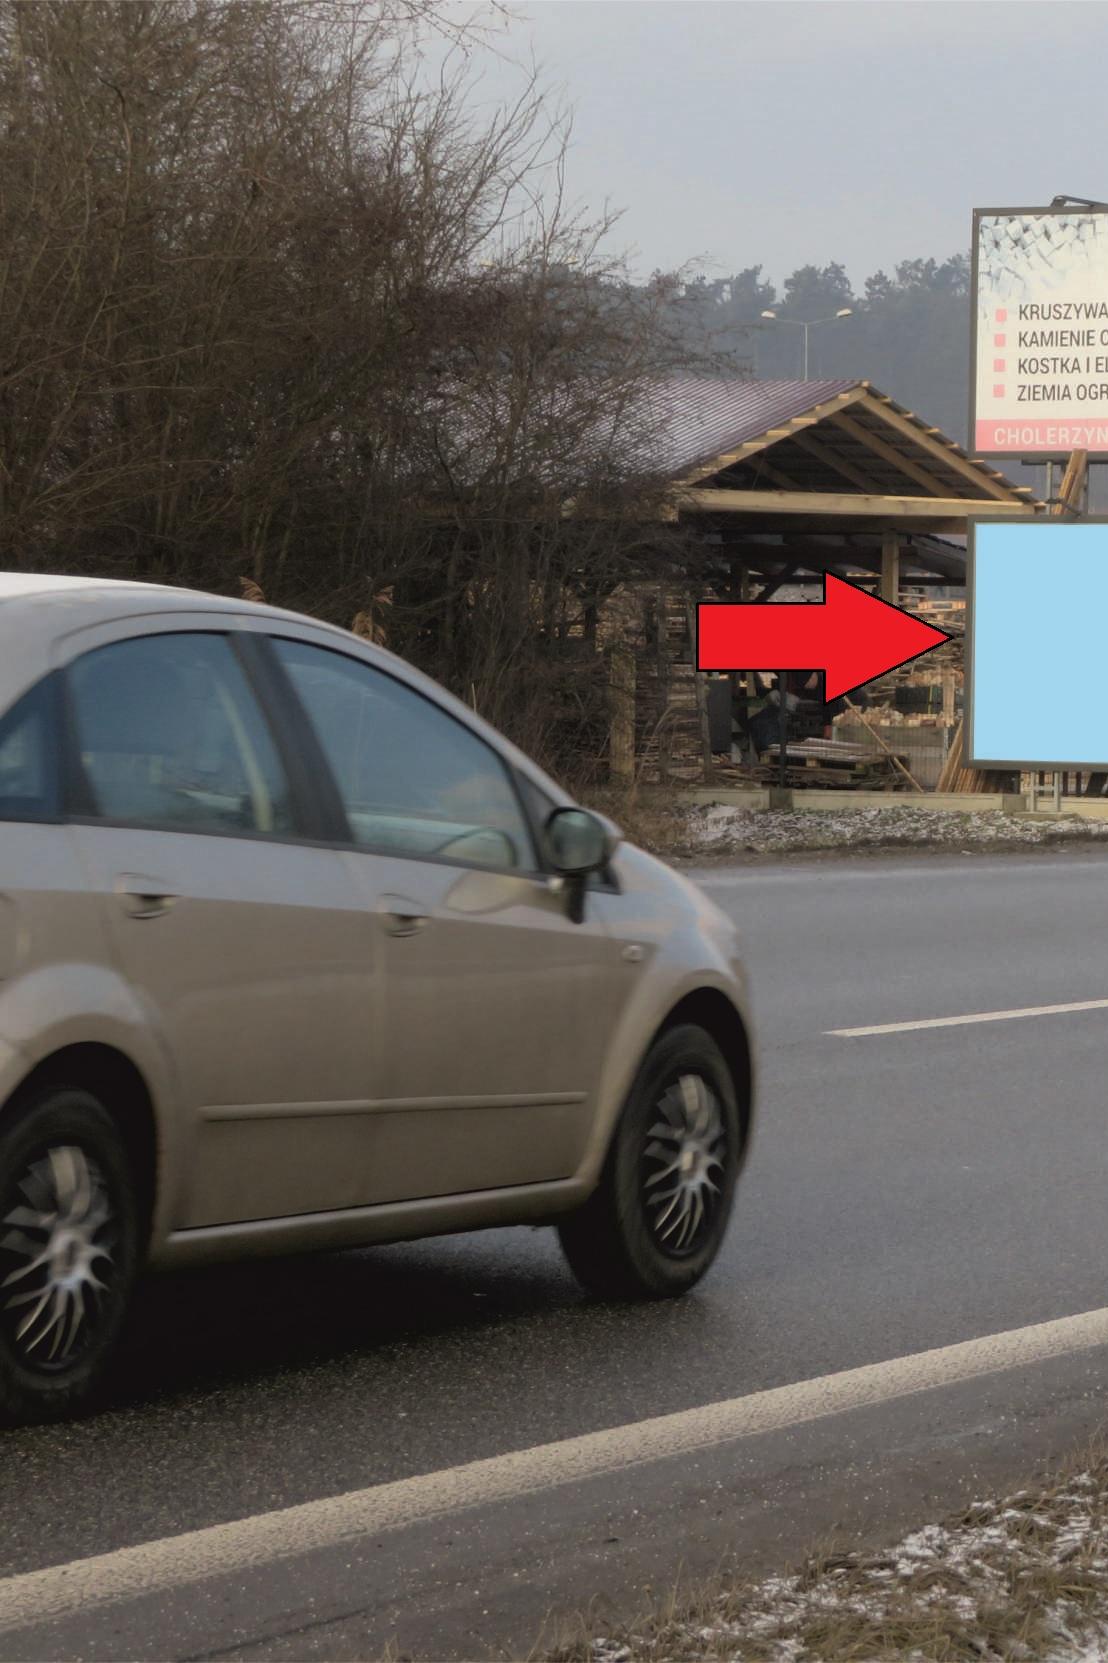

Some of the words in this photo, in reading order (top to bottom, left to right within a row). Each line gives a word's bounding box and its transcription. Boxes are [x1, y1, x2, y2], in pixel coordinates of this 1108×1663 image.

[1018, 302, 1108, 321] KRUSZYWA
[1018, 330, 1096, 348] KAMIENIE
[1018, 357, 1081, 375] KOSTKA
[1086, 357, 1090, 373] I
[1017, 384, 1072, 402] ZIEMIA
